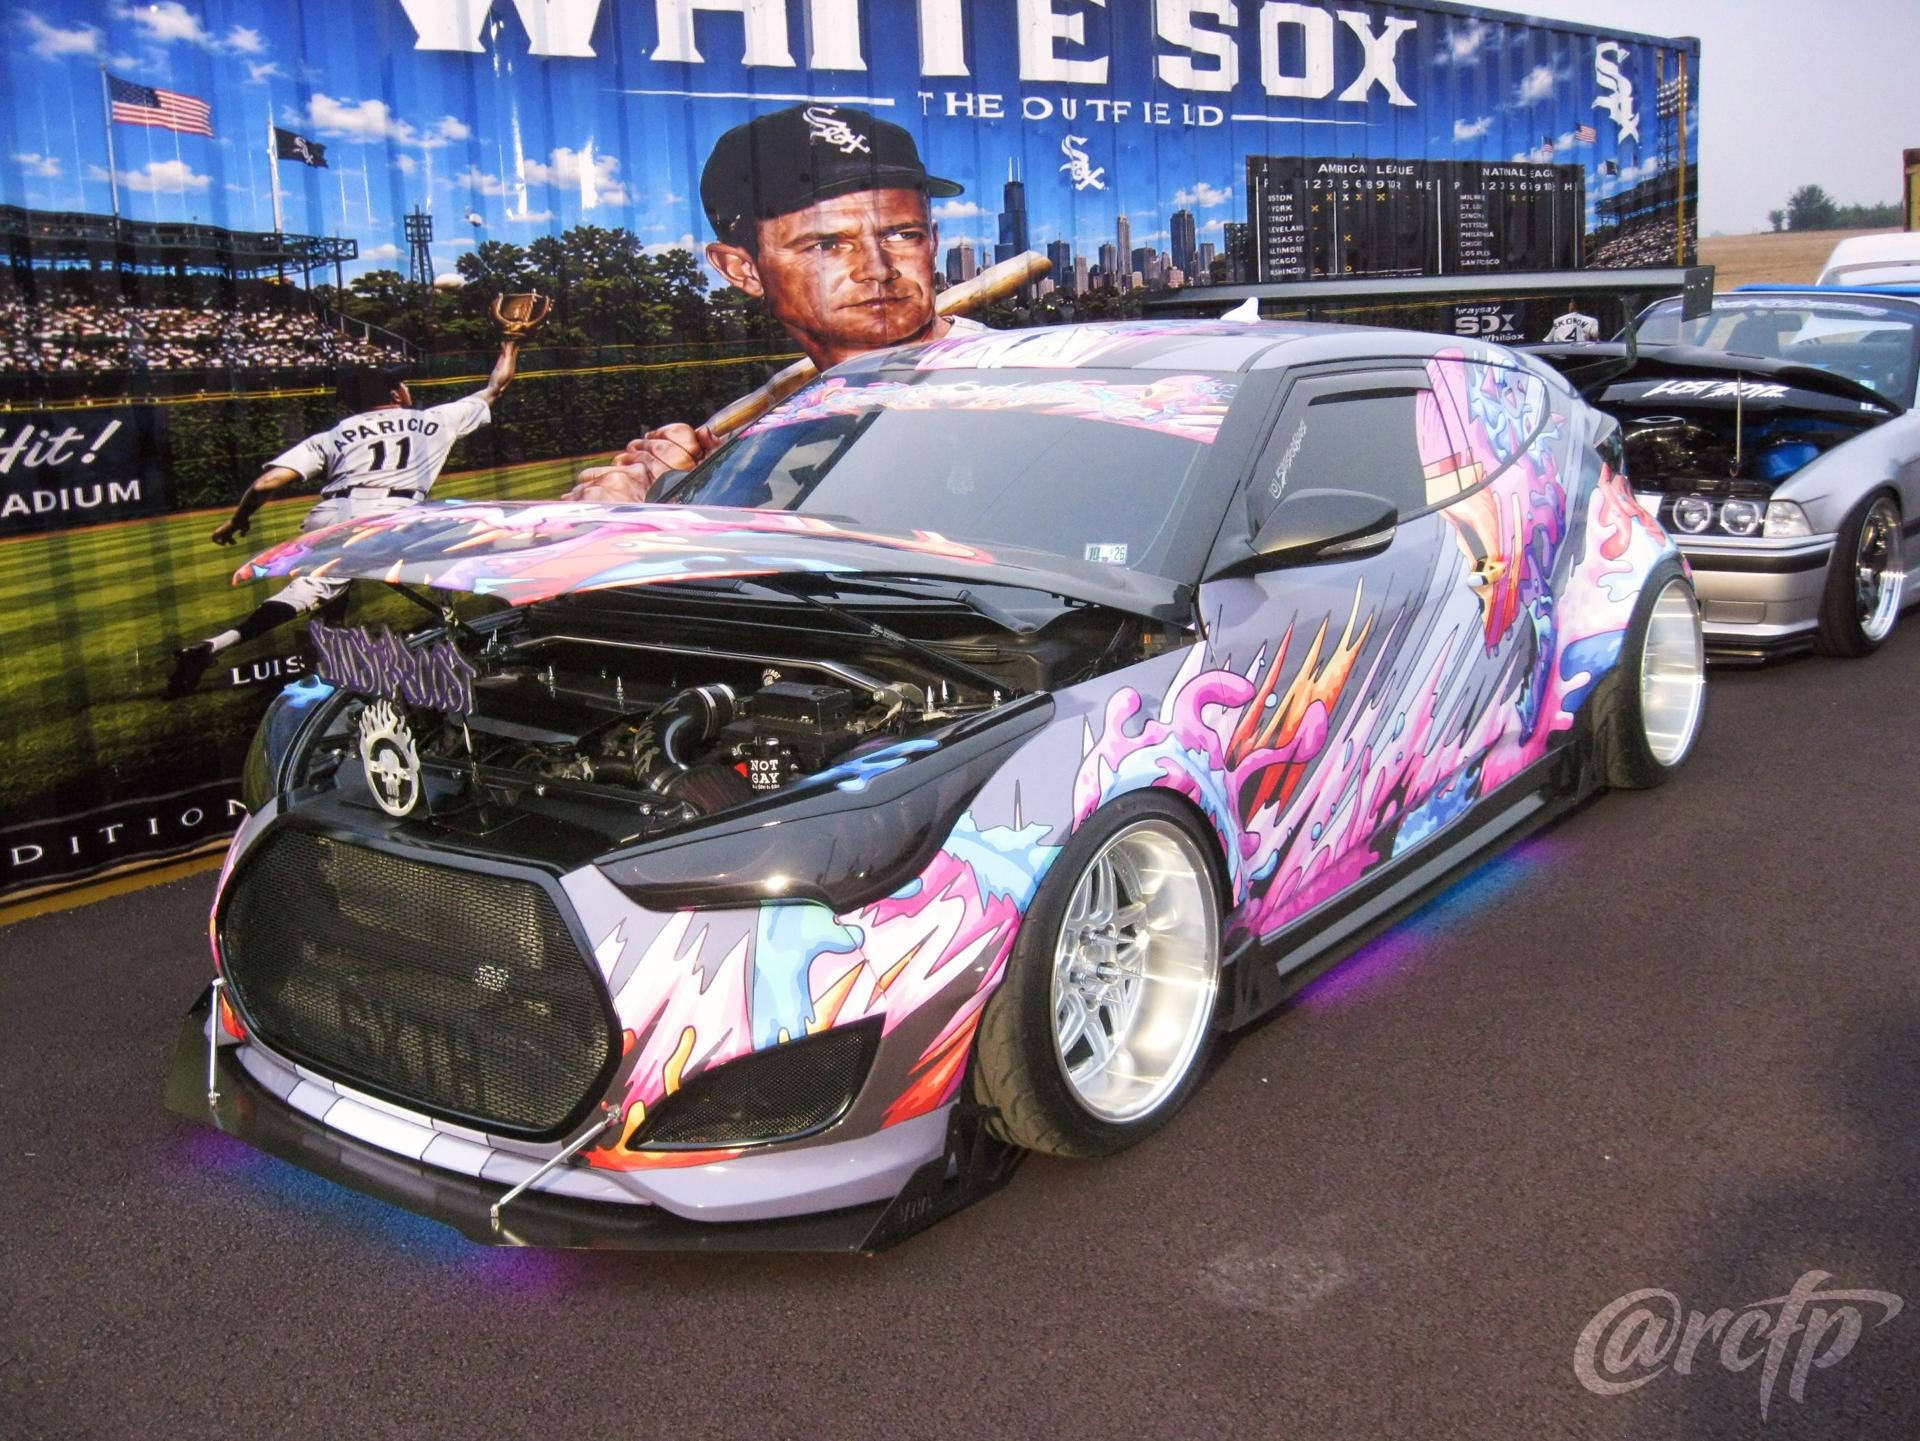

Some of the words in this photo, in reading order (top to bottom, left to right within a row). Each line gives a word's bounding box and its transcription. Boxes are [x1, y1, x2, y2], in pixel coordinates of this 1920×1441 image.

[1155, 0, 1417, 106] SOX
[918, 91, 1005, 118] THE
[1022, 96, 1224, 127] OUTFIELD
[1313, 180, 1321, 189] 2
[1376, 180, 1385, 189] 9
[333, 418, 439, 452] APARICIO
[368, 436, 410, 471] 11
[231, 656, 305, 685] LUIS
[750, 759, 779, 771] NOT
[752, 772, 780, 784] GAY
